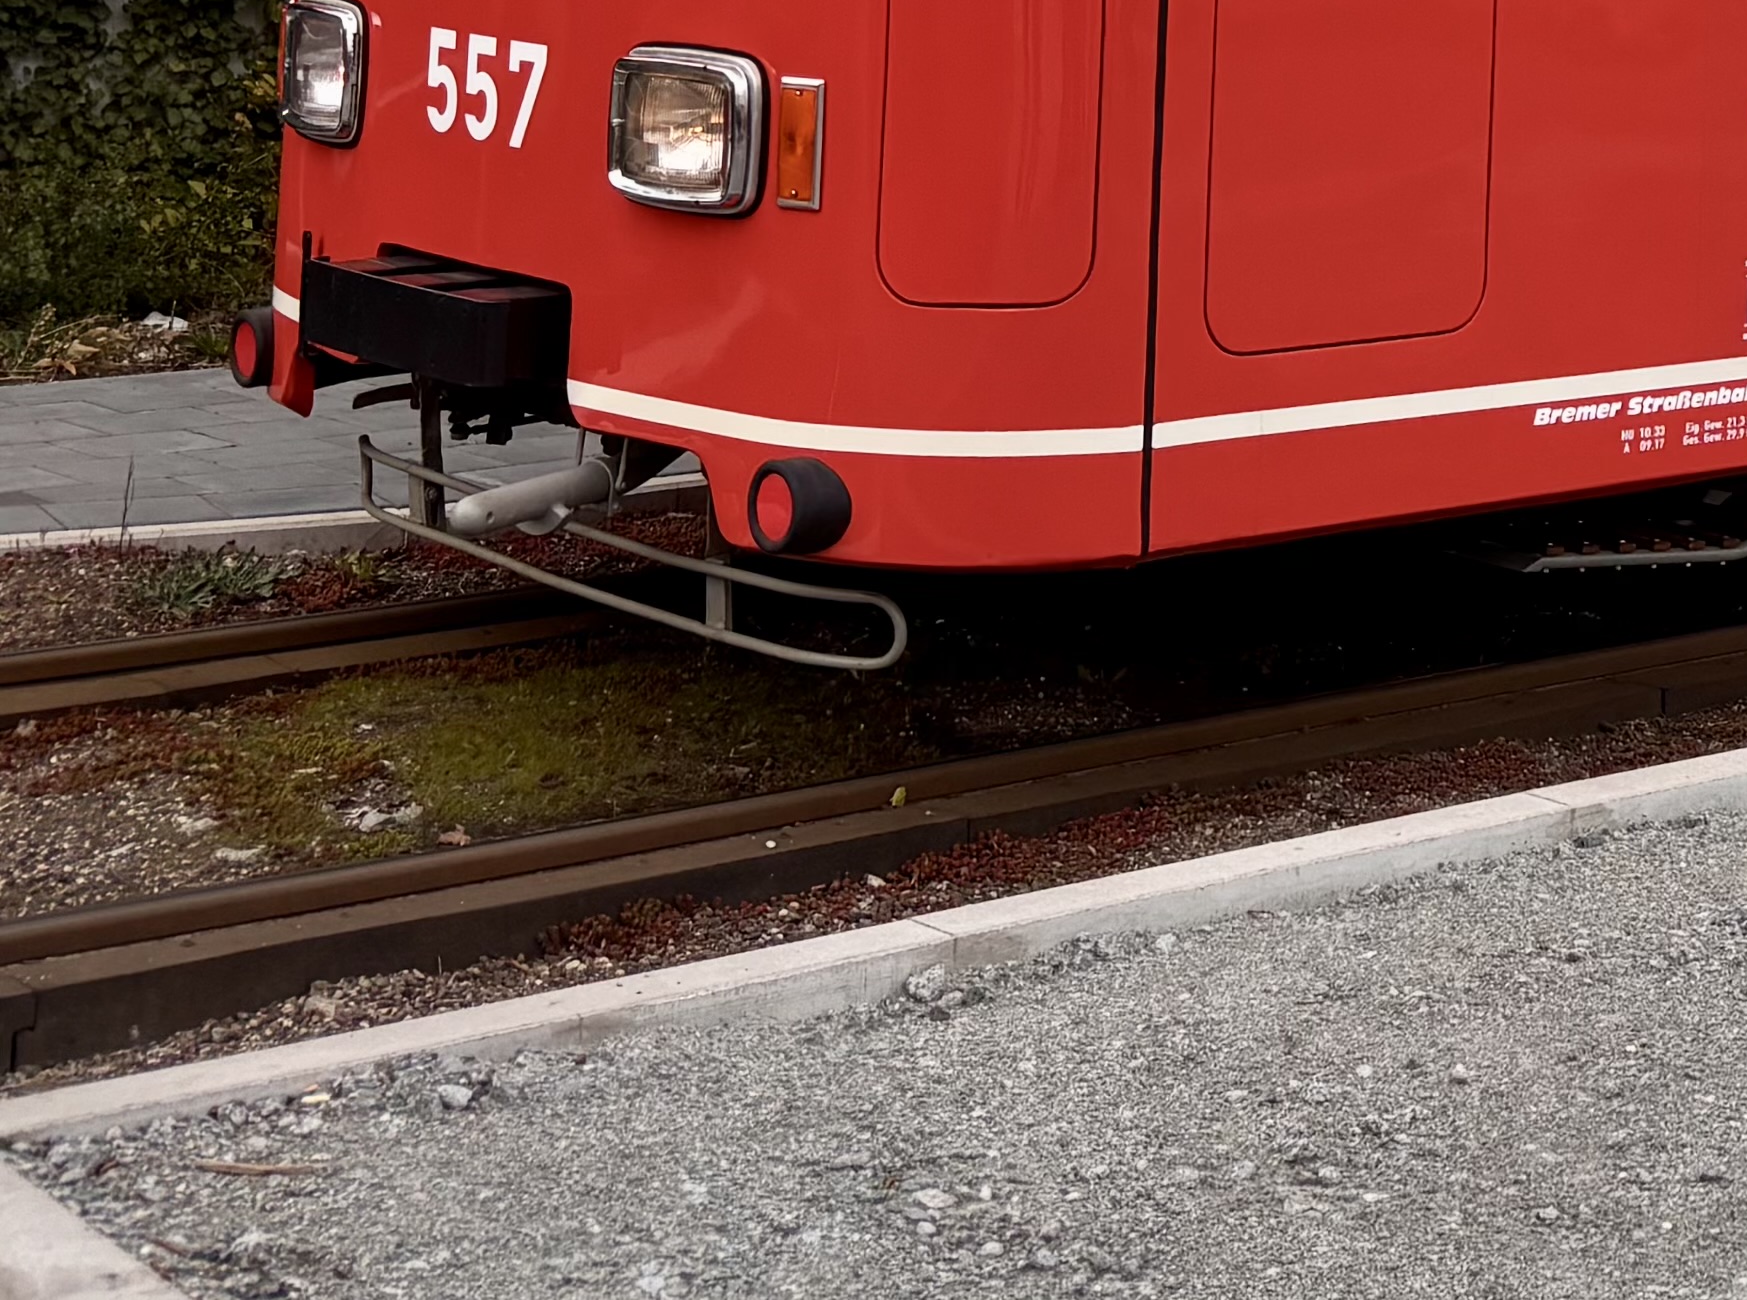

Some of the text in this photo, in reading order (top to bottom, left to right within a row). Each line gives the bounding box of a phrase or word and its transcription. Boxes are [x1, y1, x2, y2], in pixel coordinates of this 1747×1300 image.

[426, 26, 548, 149] 557
[1533, 400, 1622, 426] Bremer
[1623, 442, 1630, 454] A
